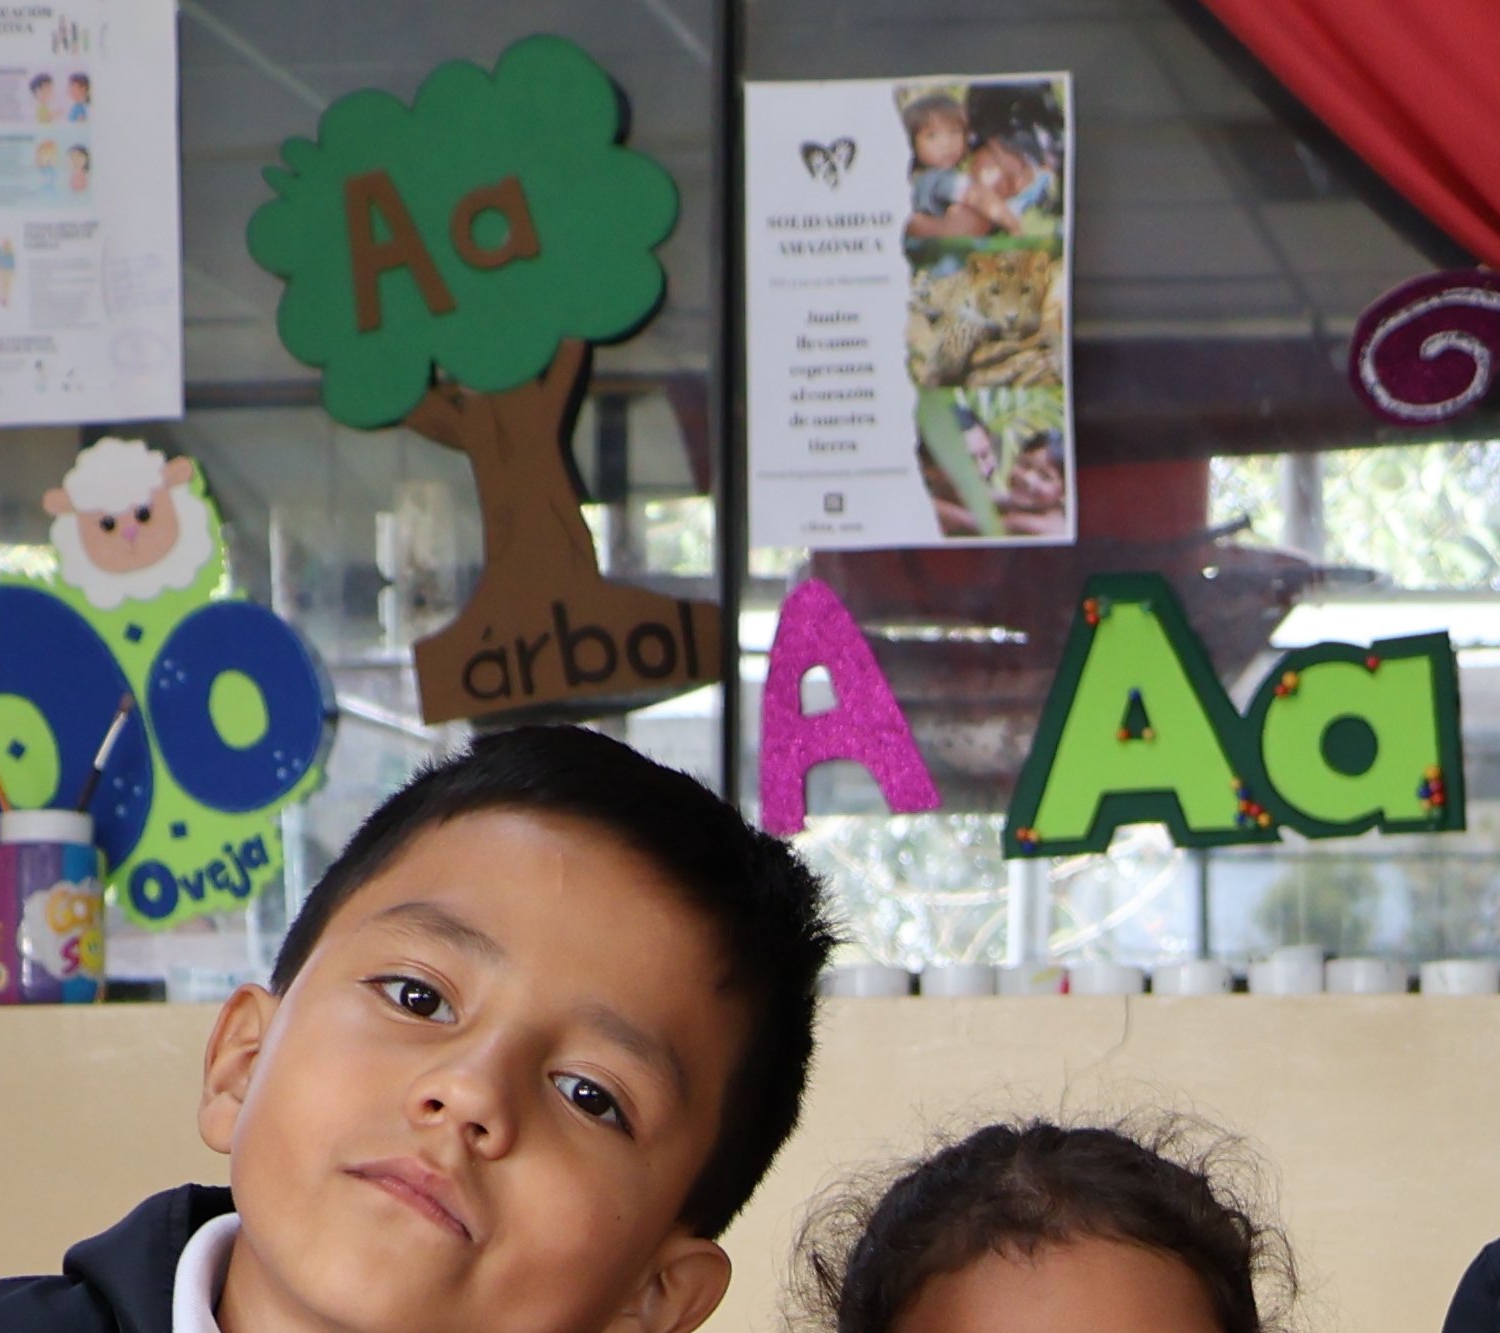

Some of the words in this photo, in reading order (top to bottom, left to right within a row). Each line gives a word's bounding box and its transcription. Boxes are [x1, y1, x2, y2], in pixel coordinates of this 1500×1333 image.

[765, 211, 894, 229] SOLIDARIDAD
[343, 165, 542, 333] Aa
[796, 334, 869, 349] llevamos
[807, 310, 860, 325] Juntos
[789, 362, 875, 378] esperanza
[789, 412, 806, 427] de
[811, 412, 877, 427] nuestra
[462, 601, 698, 699] árbol
[760, 578, 944, 837] A
[1004, 572, 1465, 860] Aa
[128, 832, 269, 919] Oveja
